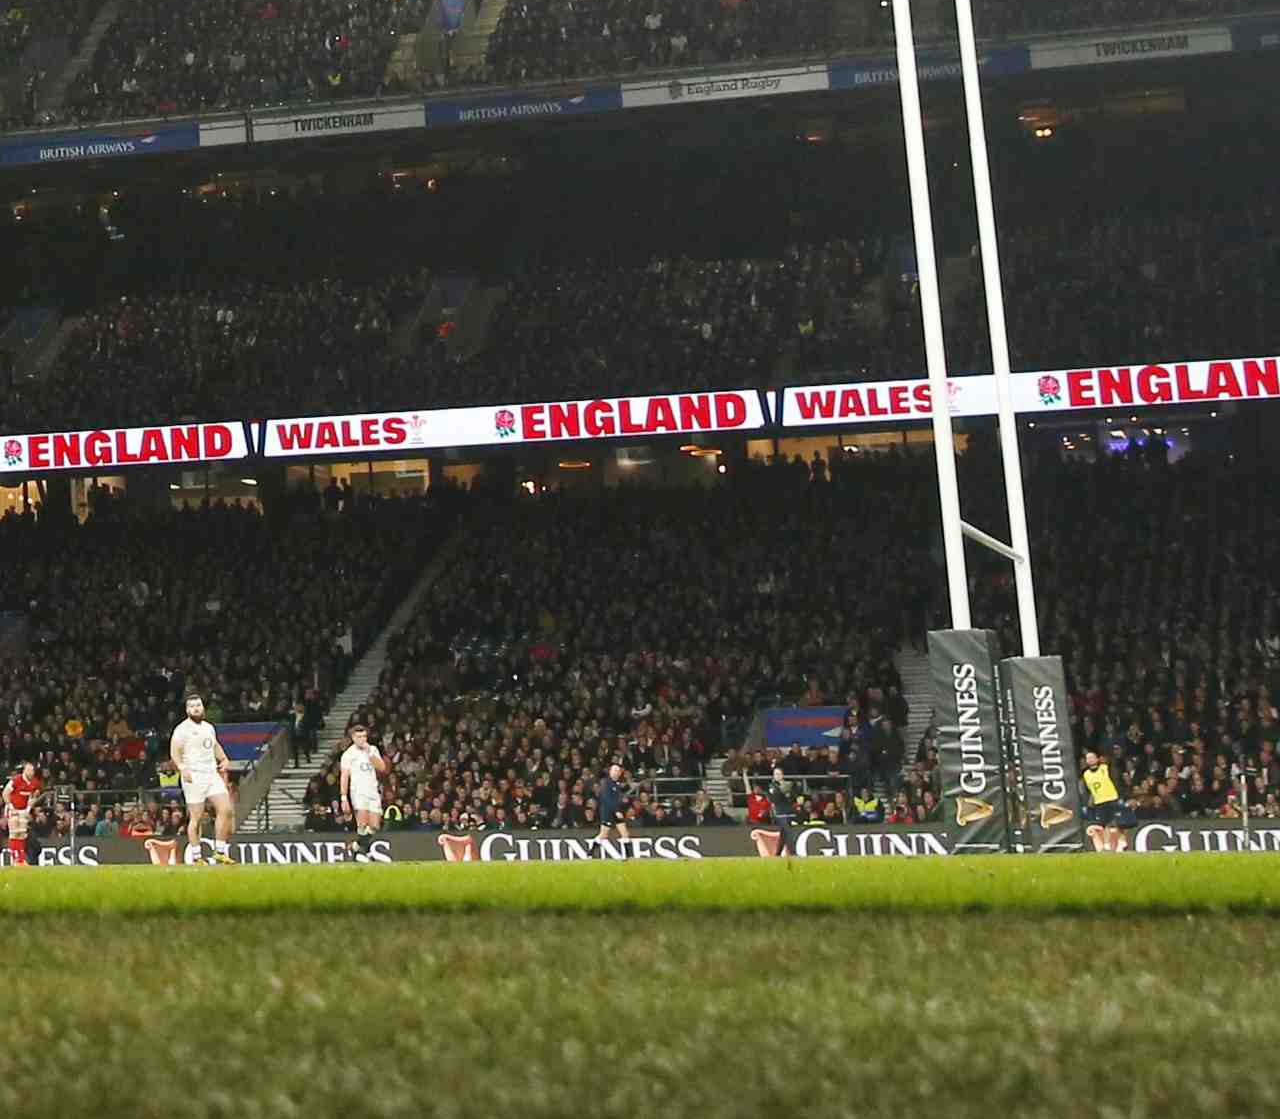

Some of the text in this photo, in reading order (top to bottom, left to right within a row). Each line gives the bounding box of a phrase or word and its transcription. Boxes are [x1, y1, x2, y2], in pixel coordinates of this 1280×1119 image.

[687, 76, 782, 96] England Rugby
[854, 68, 897, 84] BRITIS
[293, 112, 374, 133] TWICKENHAM
[459, 101, 563, 122] BRITISH AIRWAYS
[39, 141, 136, 160] BRITISH AIRWAYS
[1066, 358, 1280, 407] ENGLAN
[520, 392, 747, 440] ENGLAND
[795, 385, 933, 419] WALES
[27, 423, 234, 469] ENGLAND
[277, 416, 408, 450] WALES
[952, 662, 987, 794] GUINNESS
[1032, 685, 1067, 801] GUINNESS
[480, 833, 704, 861] GUINNESS
[795, 828, 948, 857] GUINN
